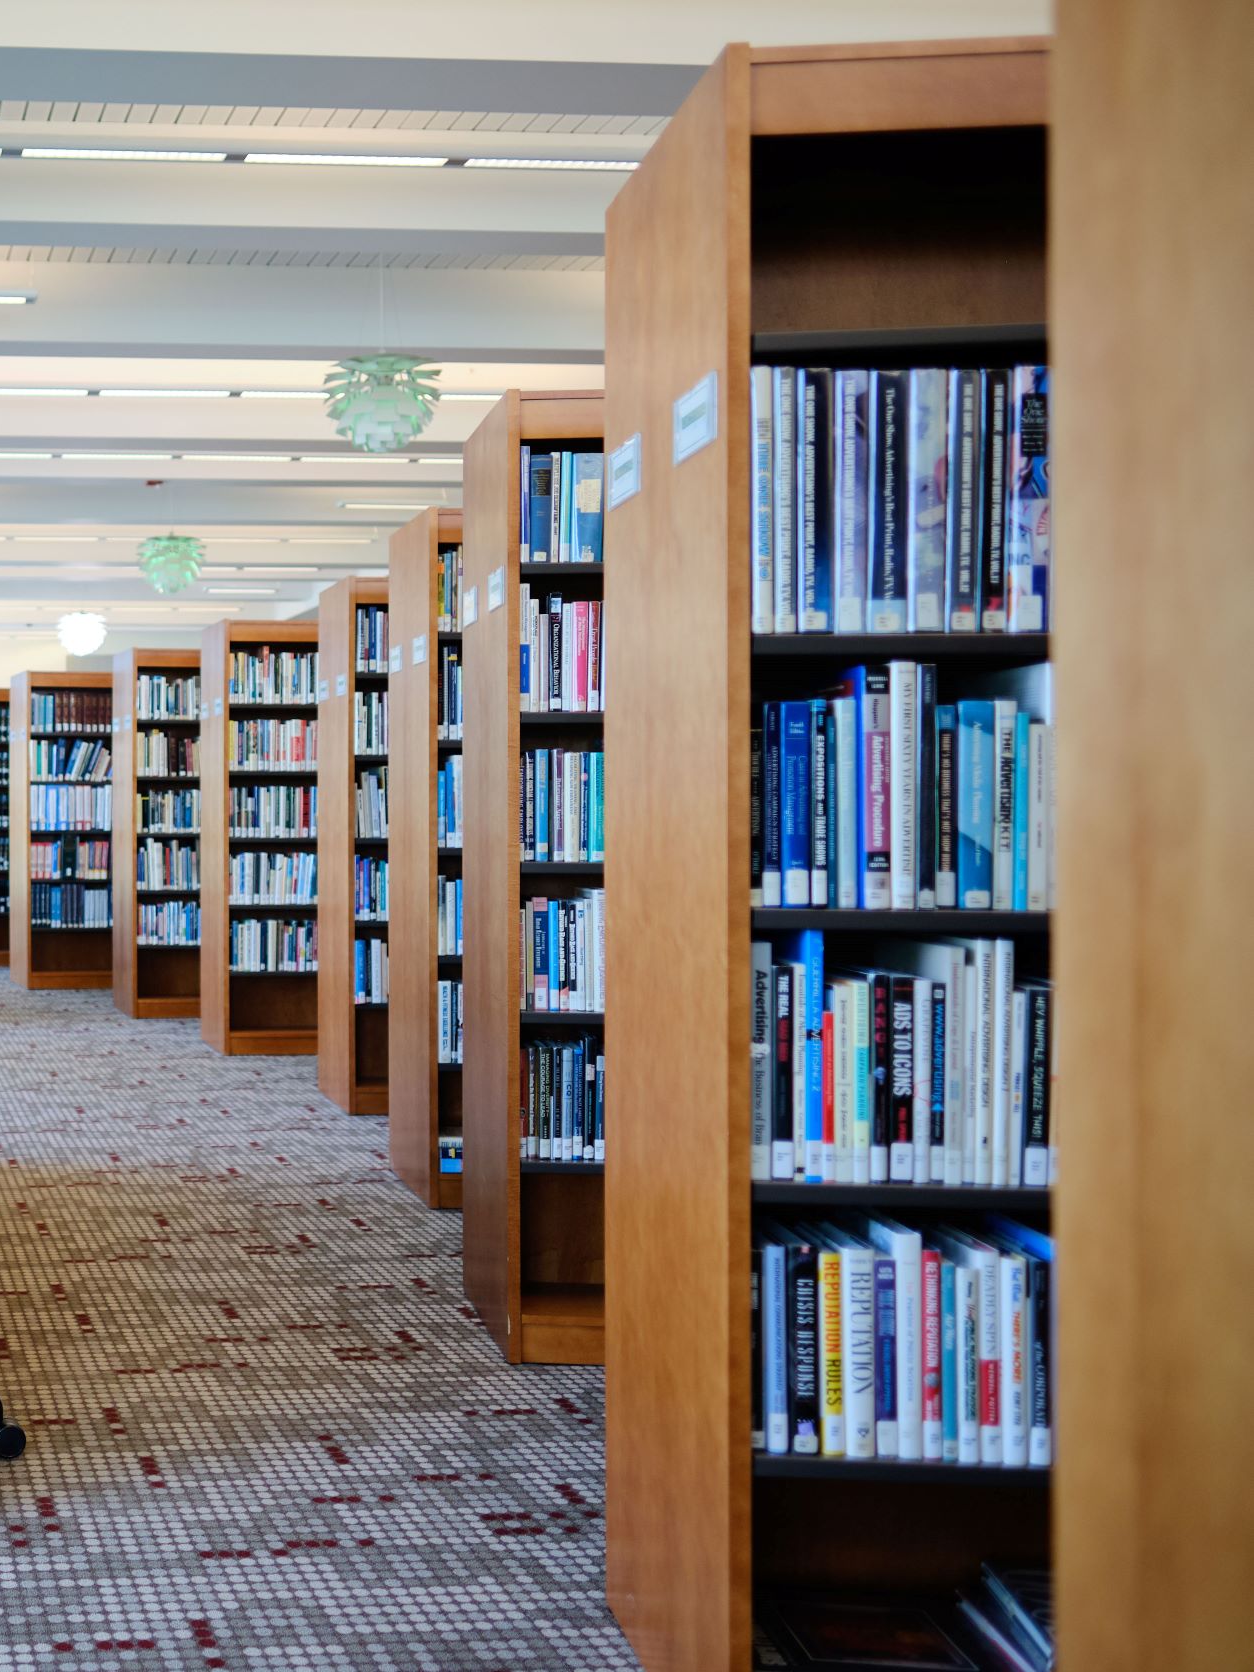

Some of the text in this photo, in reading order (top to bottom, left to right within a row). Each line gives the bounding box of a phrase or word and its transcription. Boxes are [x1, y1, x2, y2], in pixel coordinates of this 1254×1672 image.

[780, 379, 793, 395] THE
[805, 385, 816, 399] THE
[843, 380, 855, 395] THE
[885, 389, 896, 404] The
[963, 384, 974, 395] THE
[963, 397, 974, 412] ONE
[993, 384, 1003, 396] THE
[993, 397, 1003, 412] ONE
[805, 400, 816, 416] ONE
[884, 405, 896, 423] One
[757, 442, 771, 472] THE
[805, 444, 816, 502] ADVERTISING'S
[884, 448, 896, 503] Advertising's
[962, 437, 973, 489] ADVERTISING'S
[992, 435, 1002, 486] ADVERTISING'S
[757, 476, 771, 507] ONE
[805, 502, 816, 521] BEST
[884, 503, 895, 521] Best
[961, 490, 972, 507] BEST
[991, 486, 1002, 504] BEST
[757, 511, 771, 558] SHOW
[884, 522, 895, 548] Print,
[553, 623, 561, 695] ORGANIZATIONAL BEHAVIOR
[902, 682, 913, 816] MY FIRST SIXTY YEARS IN
[971, 721, 983, 762] Advertising
[815, 735, 825, 801] EXPOSITIONS
[784, 755, 796, 835] Promotion Management
[815, 802, 825, 815] AND
[870, 735, 884, 847] Advertising Procedure
[941, 734, 952, 852] THERE'S NO BUSINESS THAT'S NOT SHOW
[1000, 730, 1013, 849] THE Advertising KIT
[815, 816, 825, 838] TRADE
[815, 840, 825, 866] SHOWS
[777, 975, 790, 993] THE
[797, 974, 806, 1008] Essentials
[811, 957, 820, 1013] GUERRILLA
[753, 970, 769, 1044] Advertising
[777, 994, 790, 1018] REAL
[1003, 951, 1011, 1085] INTERNATIONAL ADVERTISING DESIGN
[777, 1020, 790, 1040] MAD
[797, 1021, 805, 1043] Media
[811, 1016, 820, 1082] ADVERTISING
[893, 1003, 912, 1096] ADS TO ICONS
[982, 953, 990, 1108] INTERNATIONAL ADVERTISING DESIGN
[797, 1045, 805, 1076] Planning
[857, 985, 866, 1120] ADVERTISING CAMPAIGN PLANNING
[932, 1004, 944, 1104] www.advertising
[1032, 996, 1046, 1138] HEY WHIPPLE, SQUEEZE THIS!
[541, 1094, 546, 1102] TO
[754, 1052, 766, 1121] The Business of
[926, 1262, 939, 1367] RETHINKING REPUTATION
[985, 1265, 996, 1356] DEADLY SPIN
[796, 1278, 815, 1397] CRISIS RESPONSE
[825, 1261, 843, 1406] REPUTATION RULES
[849, 1272, 874, 1395] REPUTATION
[1012, 1311, 1022, 1385] THERE'S MORE!
[1035, 1351, 1046, 1361] the
